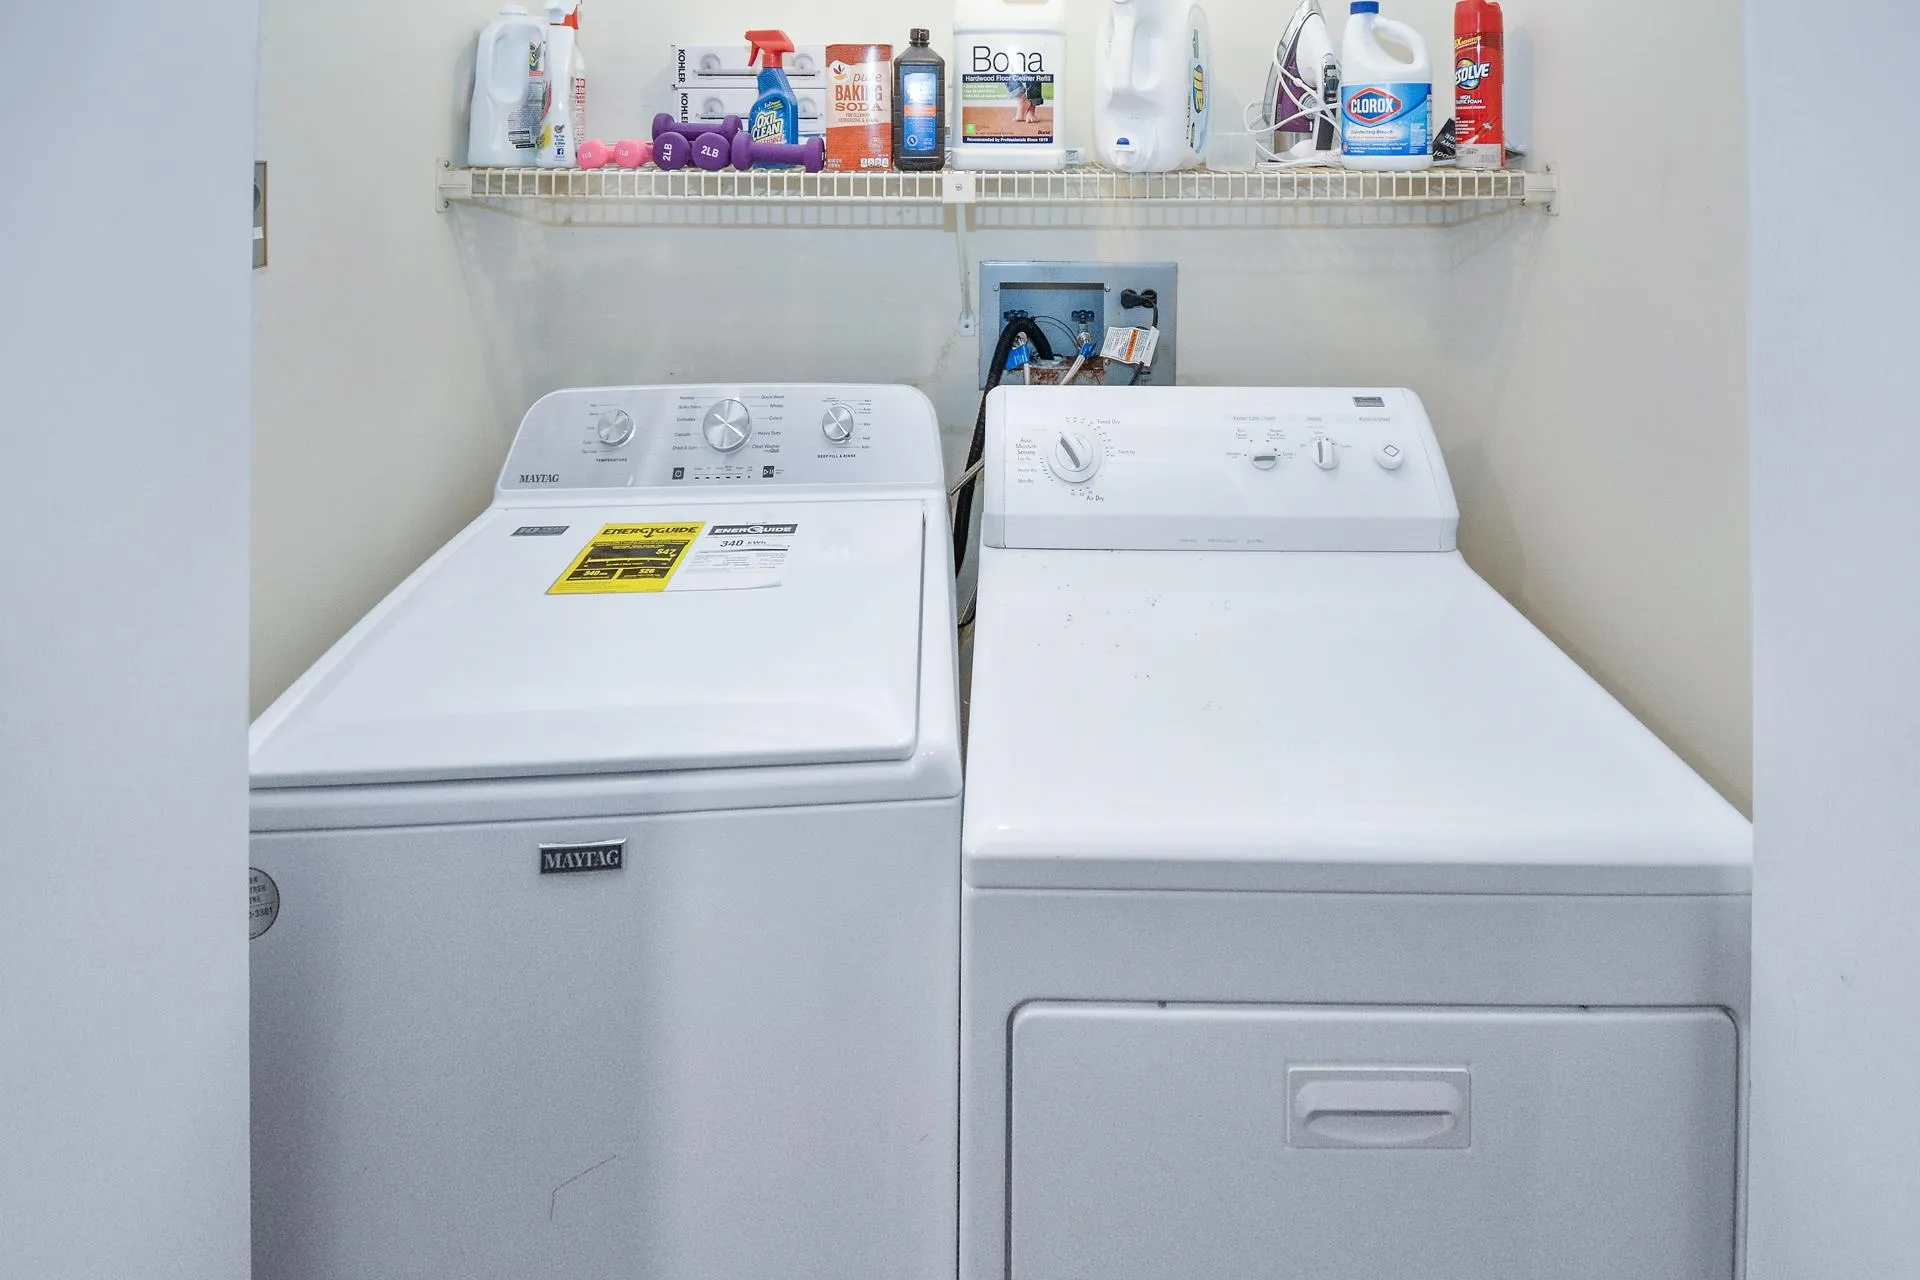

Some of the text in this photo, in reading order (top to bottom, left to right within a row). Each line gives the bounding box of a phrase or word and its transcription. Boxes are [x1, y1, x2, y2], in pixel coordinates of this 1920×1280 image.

[973, 46, 1044, 72] Bona
[1456, 63, 1490, 84] SOLVE
[680, 92, 688, 124] KOHLE
[835, 103, 883, 112] SODA
[1351, 98, 1394, 114] CLOROX
[757, 112, 774, 128] OXI
[752, 121, 781, 141] CLEAN
[663, 144, 672, 161] 2LB
[701, 146, 719, 158] 2LB
[519, 474, 559, 483] MAYTAG
[602, 526, 698, 538] ENERGYGUIDE
[714, 525, 792, 534] ENERGUIDE
[544, 848, 619, 870] MAYTAG
